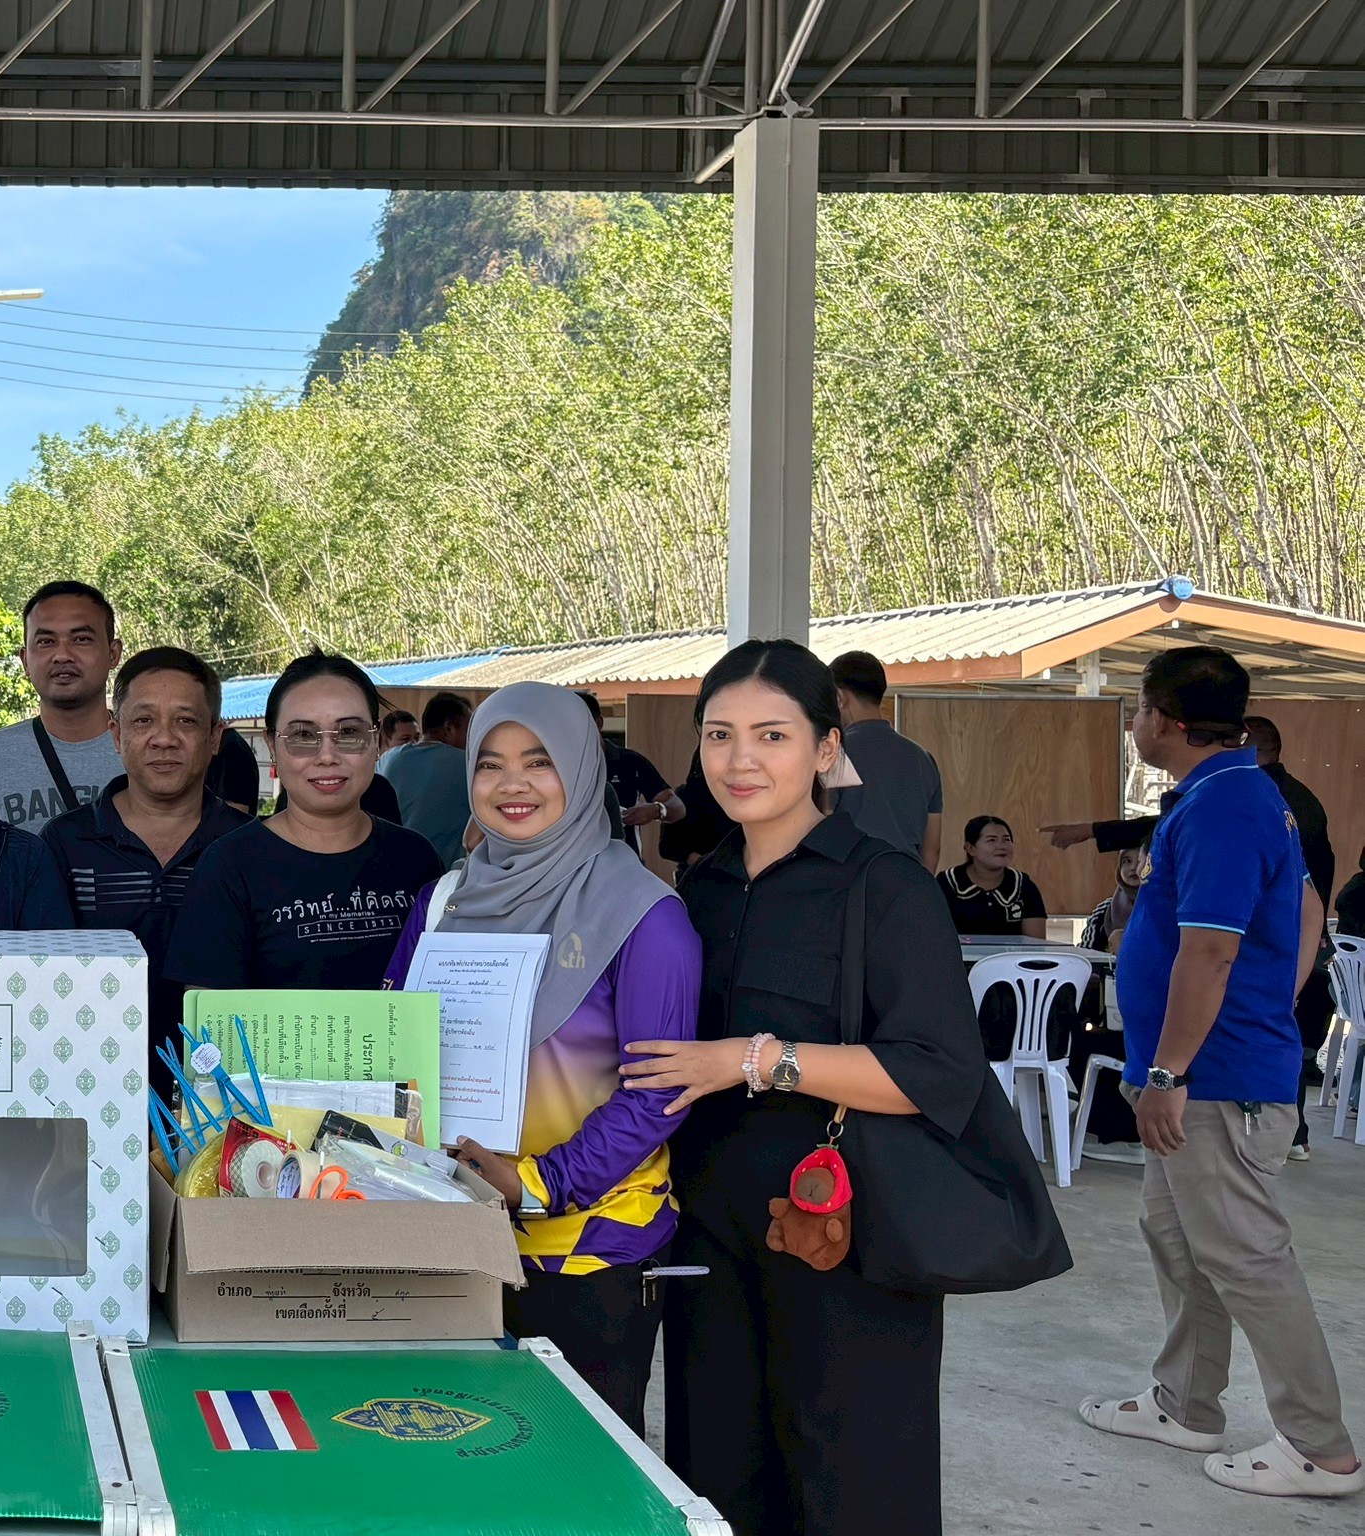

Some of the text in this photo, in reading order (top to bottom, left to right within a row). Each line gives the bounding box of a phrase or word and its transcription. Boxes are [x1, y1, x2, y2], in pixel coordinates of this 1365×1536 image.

[304, 921, 355, 934] SINCE
[217, 1282, 253, 1297] อำเภอ
[332, 1282, 371, 1298] จังหวัด
[275, 1298, 347, 1319] เขตเลือกตั้งที่
